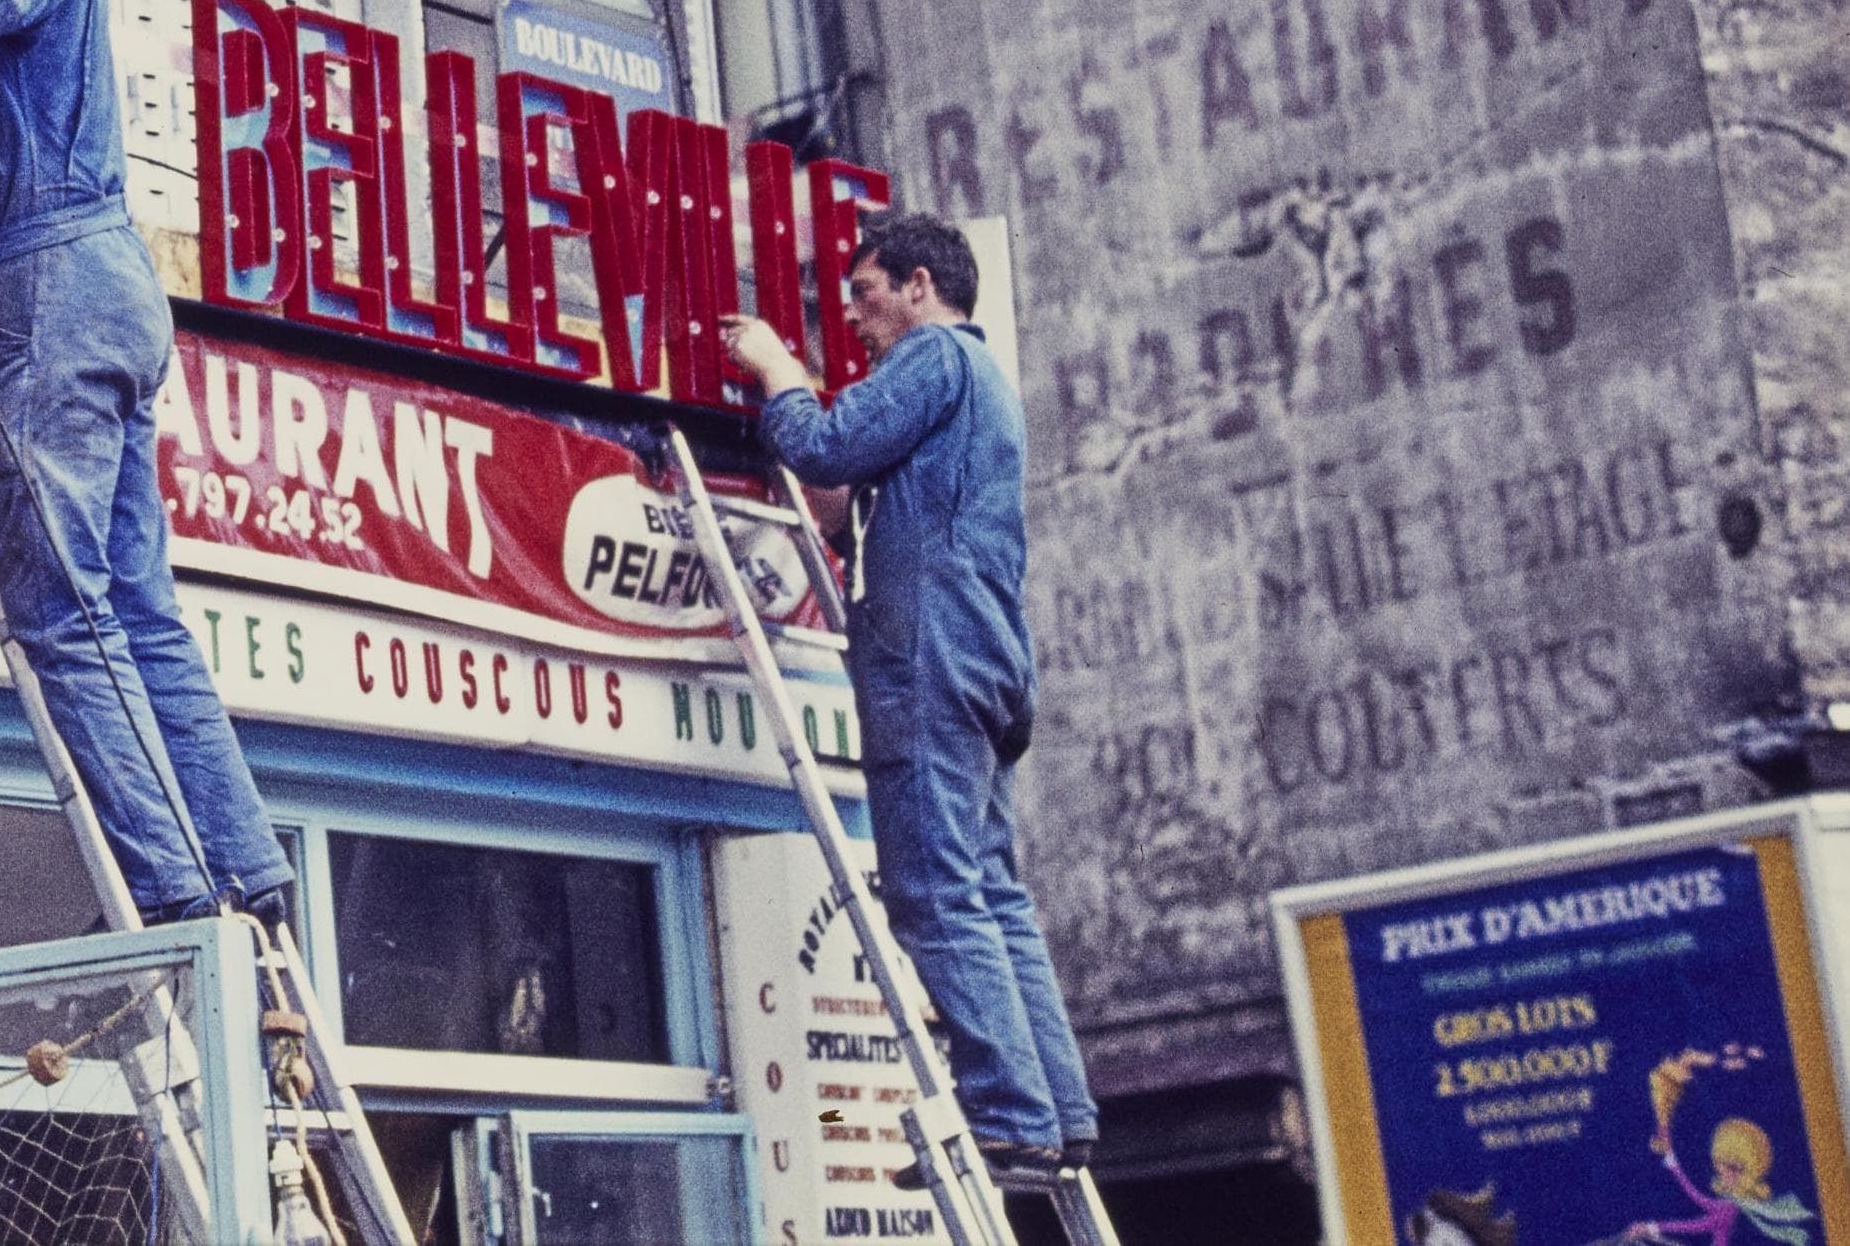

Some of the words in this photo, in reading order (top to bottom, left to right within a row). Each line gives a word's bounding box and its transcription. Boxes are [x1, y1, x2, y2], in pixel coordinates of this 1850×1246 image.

[514, 17, 664, 94] BOULEVARD
[354, 629, 625, 731] COUSCOUS
[670, 680, 849, 759] MOUON
[1380, 913, 1478, 963] PRIX
